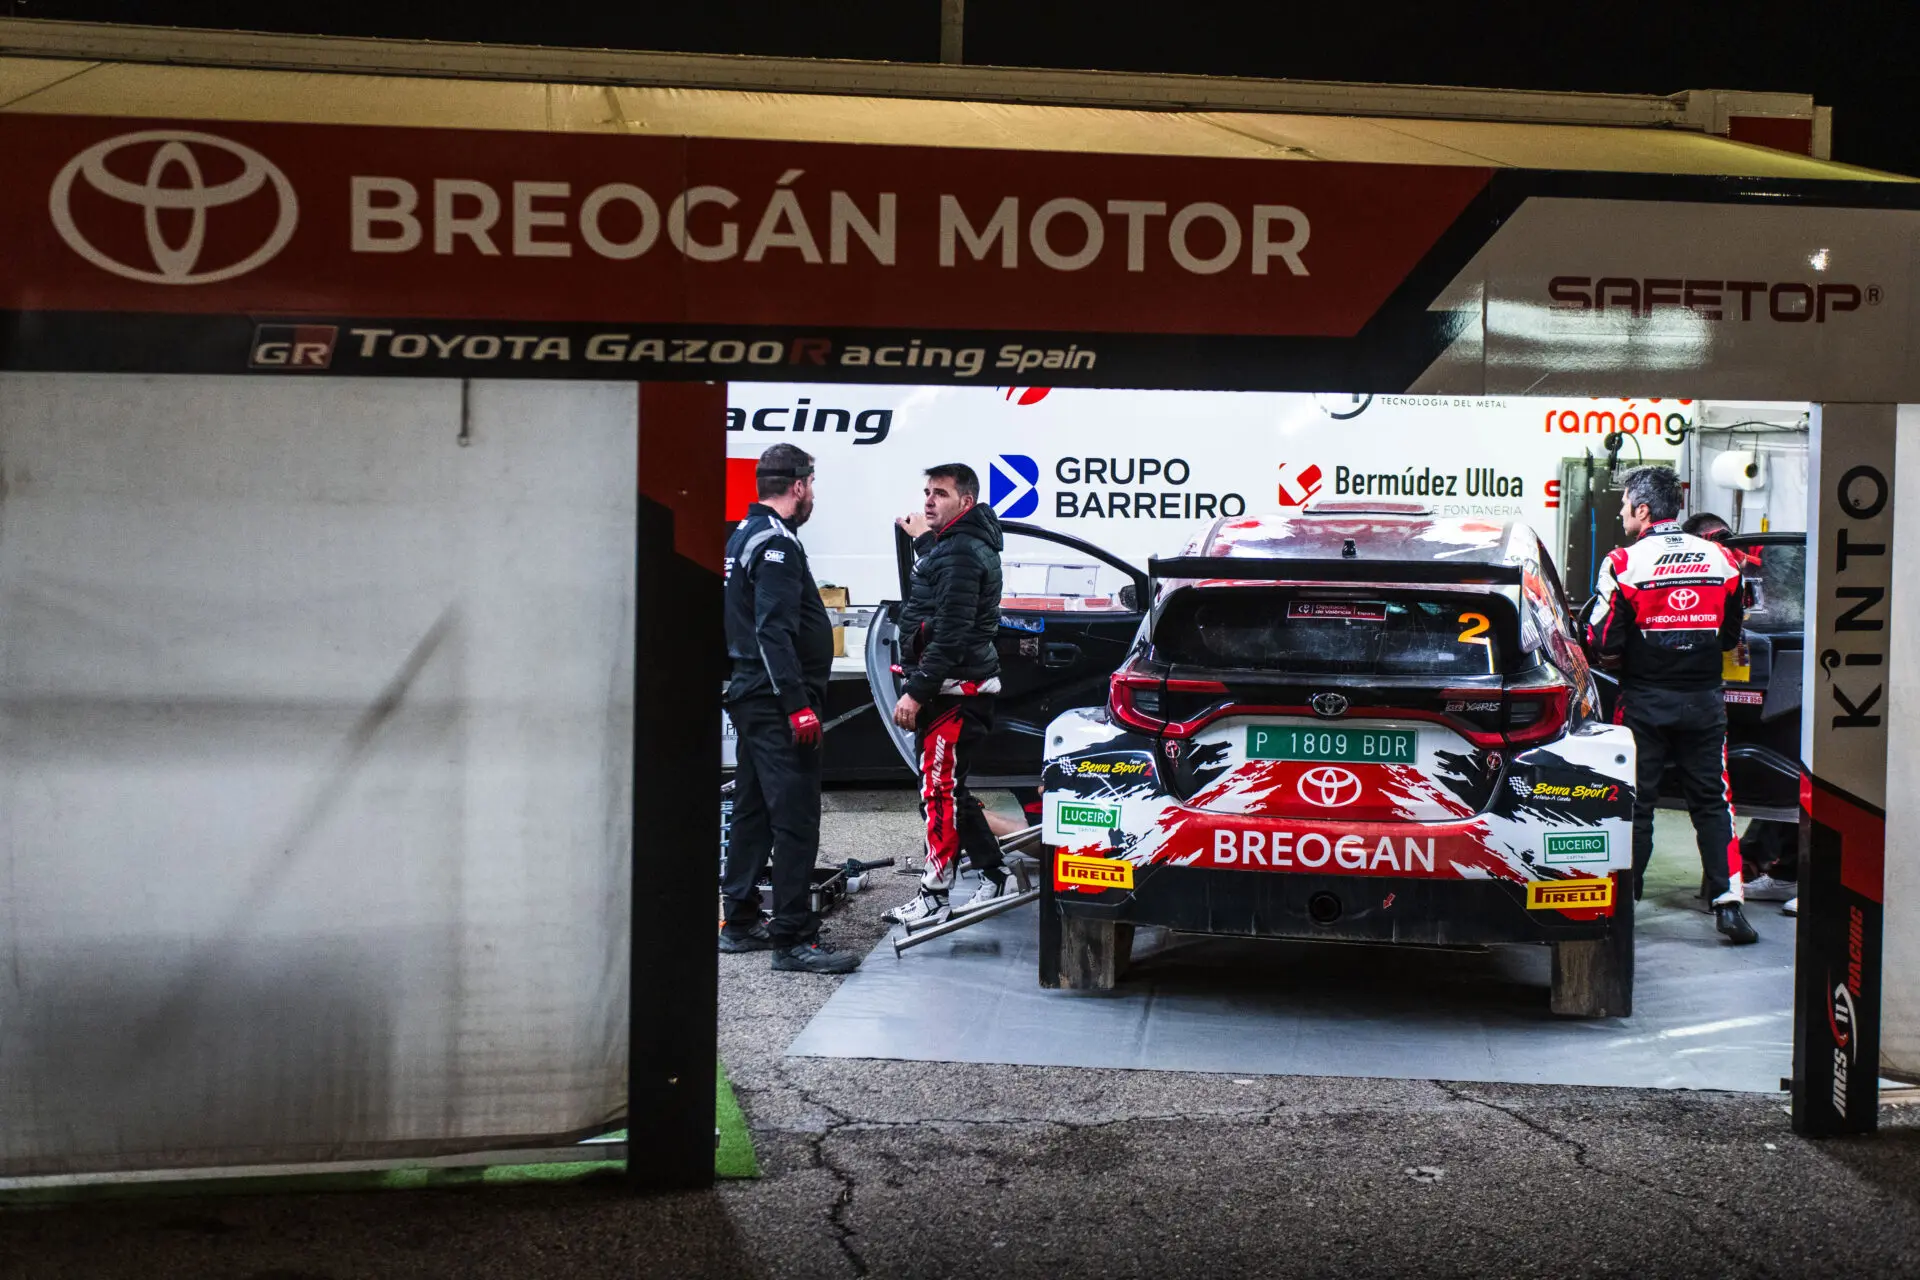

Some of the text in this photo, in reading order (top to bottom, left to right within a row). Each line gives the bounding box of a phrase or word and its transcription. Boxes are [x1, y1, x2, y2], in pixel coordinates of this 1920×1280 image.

[350, 169, 1310, 277] BREOGÁN MOTOR
[254, 342, 330, 365] GR
[350, 327, 571, 362] TOYOTA
[584, 334, 784, 366] GAZOO
[996, 344, 1096, 373] Spain
[1453, 398, 1472, 408] DEL
[1475, 399, 1508, 409] METAL
[1055, 456, 1191, 486] GRUPO
[1335, 465, 1458, 497] Bermúdez
[1465, 467, 1524, 498] Ulloa
[1055, 490, 1246, 519] BARREIRO
[1653, 563, 1711, 577] RACING
[1457, 612, 1490, 645] 2
[1690, 613, 1718, 623] MOTOR
[1255, 731, 1409, 758] P 1809 BDR
[1111, 761, 1147, 776] Sport
[1533, 782, 1620, 801] Senra Sport 2
[1064, 809, 1113, 824] LUCEIRO
[1213, 828, 1437, 873] BREOGAN
[1551, 839, 1602, 851] LUCEIRO
[1062, 860, 1126, 882] PIRELLI
[1535, 884, 1607, 903] PIRELLI
[1848, 905, 1863, 998] RACING
